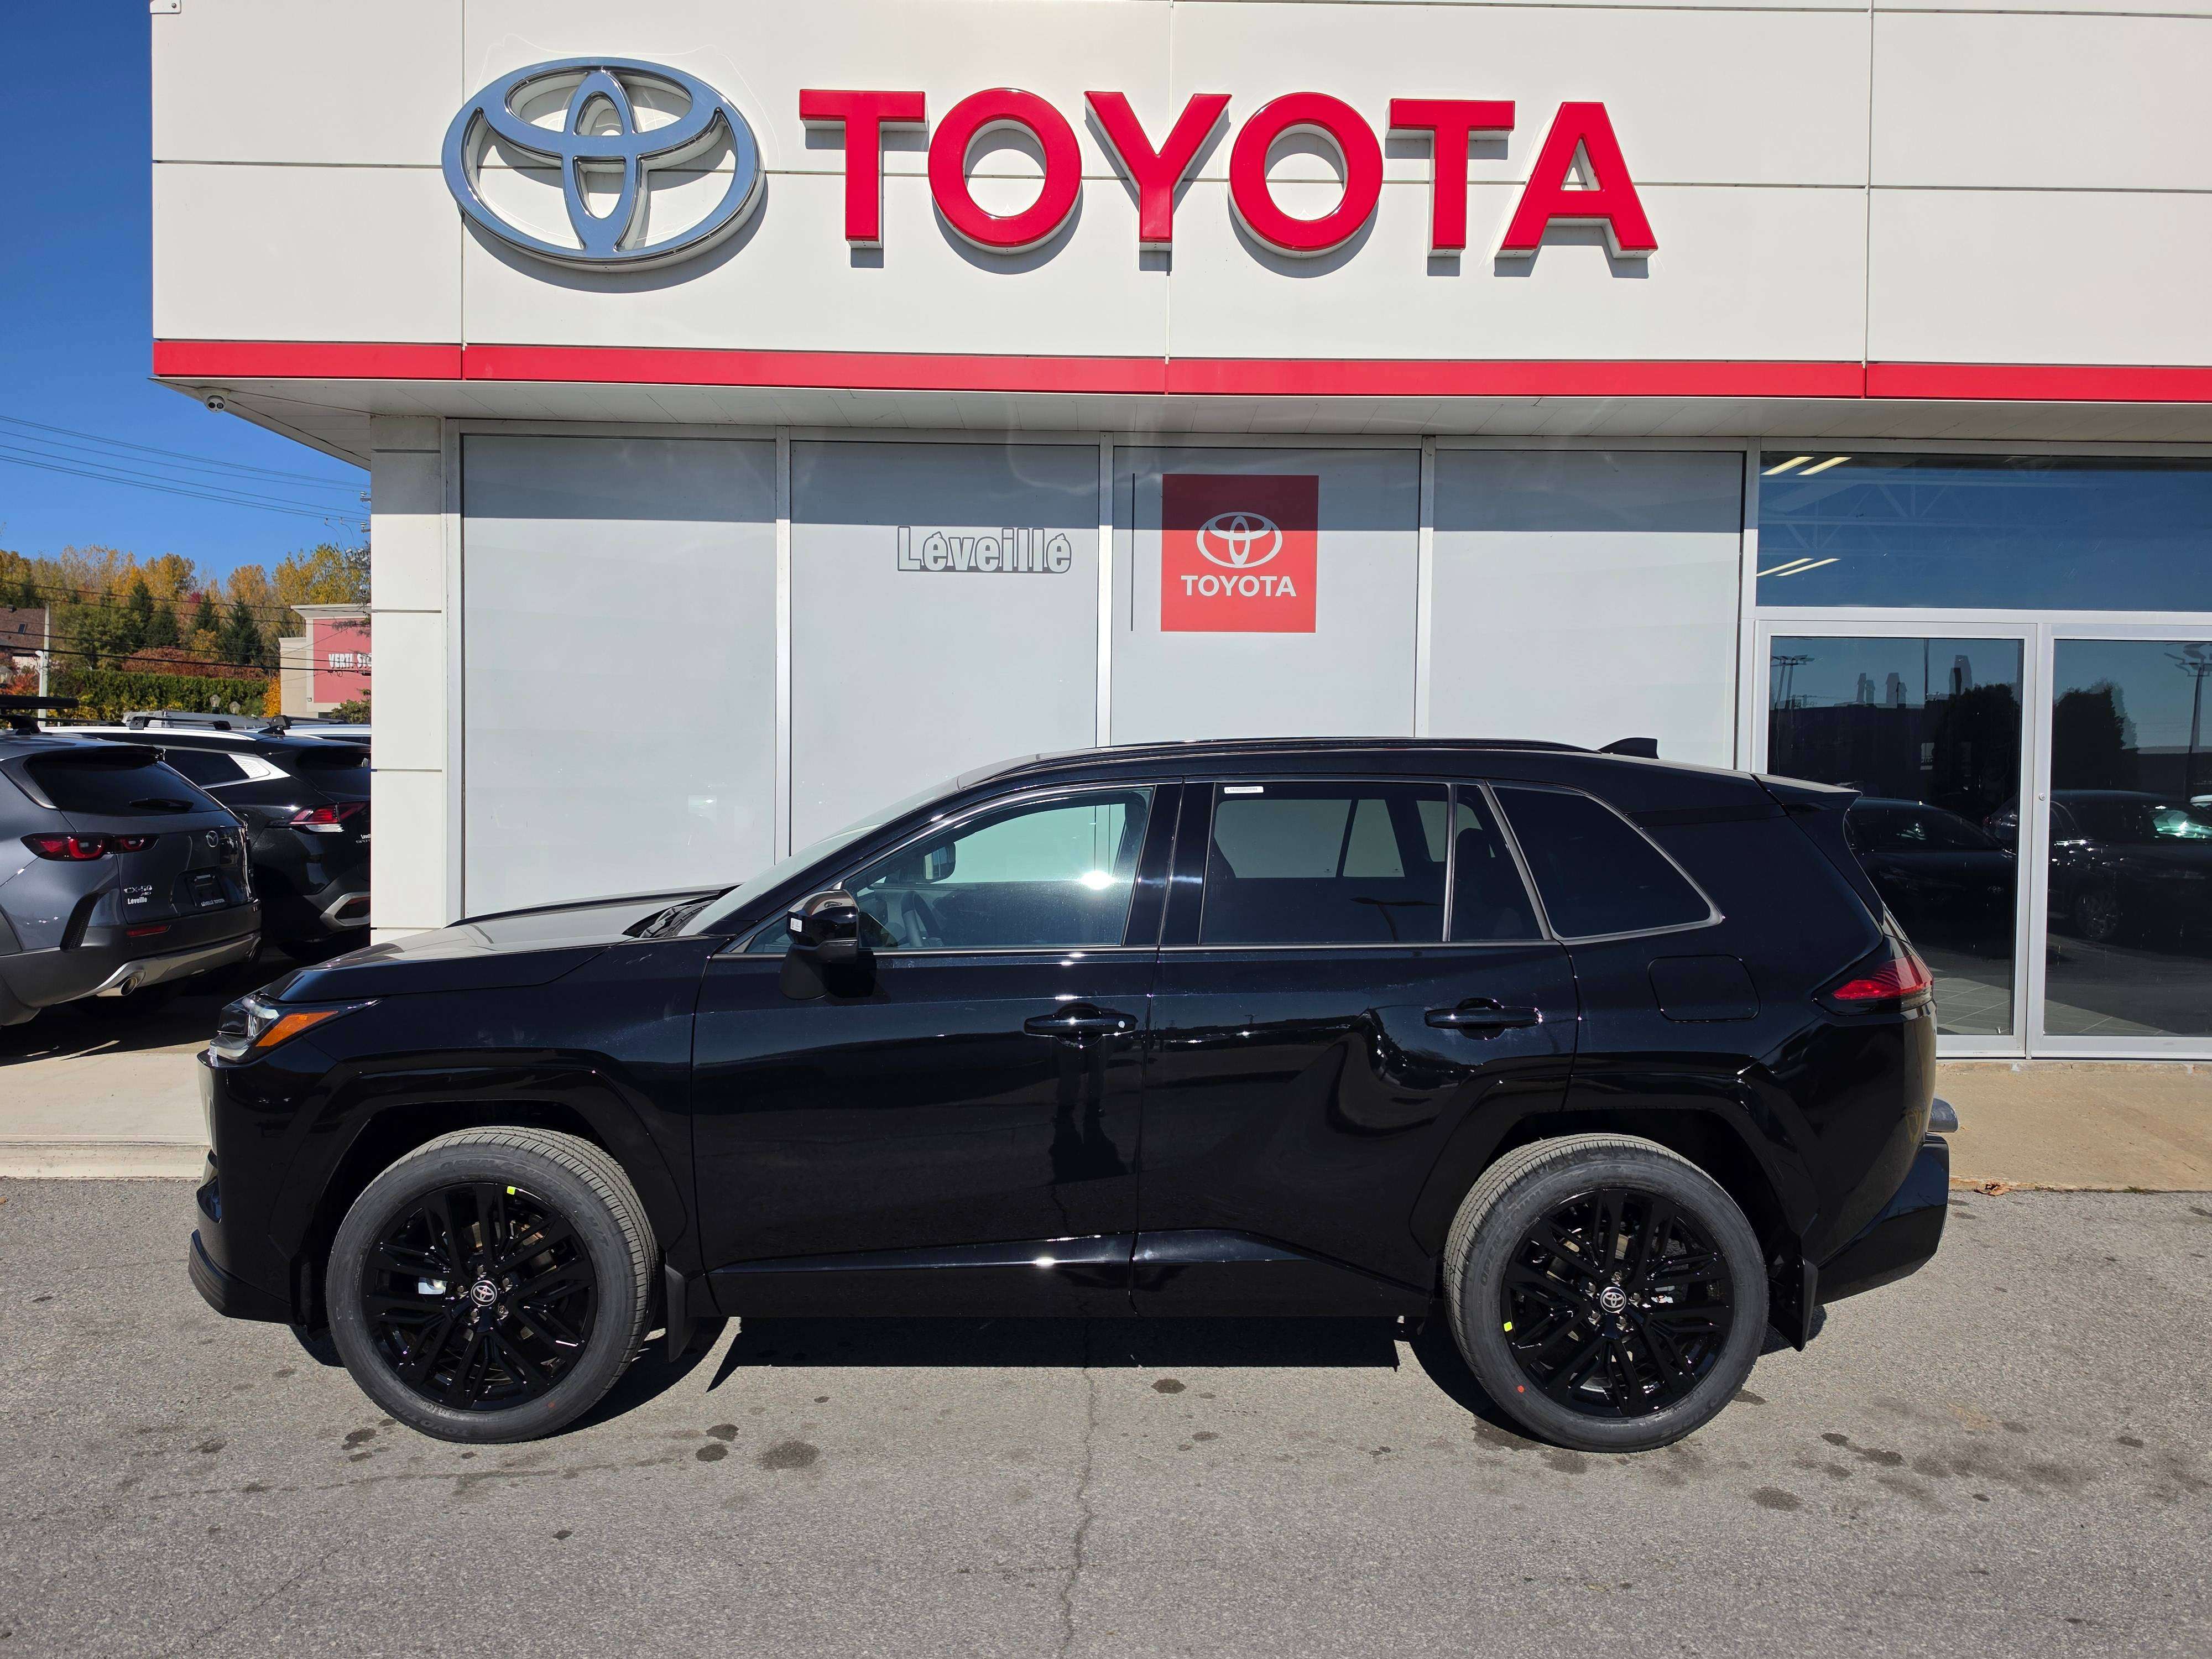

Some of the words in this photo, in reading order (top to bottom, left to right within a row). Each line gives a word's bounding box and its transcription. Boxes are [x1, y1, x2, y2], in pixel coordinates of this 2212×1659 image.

[799, 87, 1659, 258] TOYOTA
[898, 526, 1072, 573] Léveillé
[1181, 575, 1297, 597] TOYOTA
[328, 653, 353, 668] VERTI
[439, 1158, 495, 1173] OPEN
